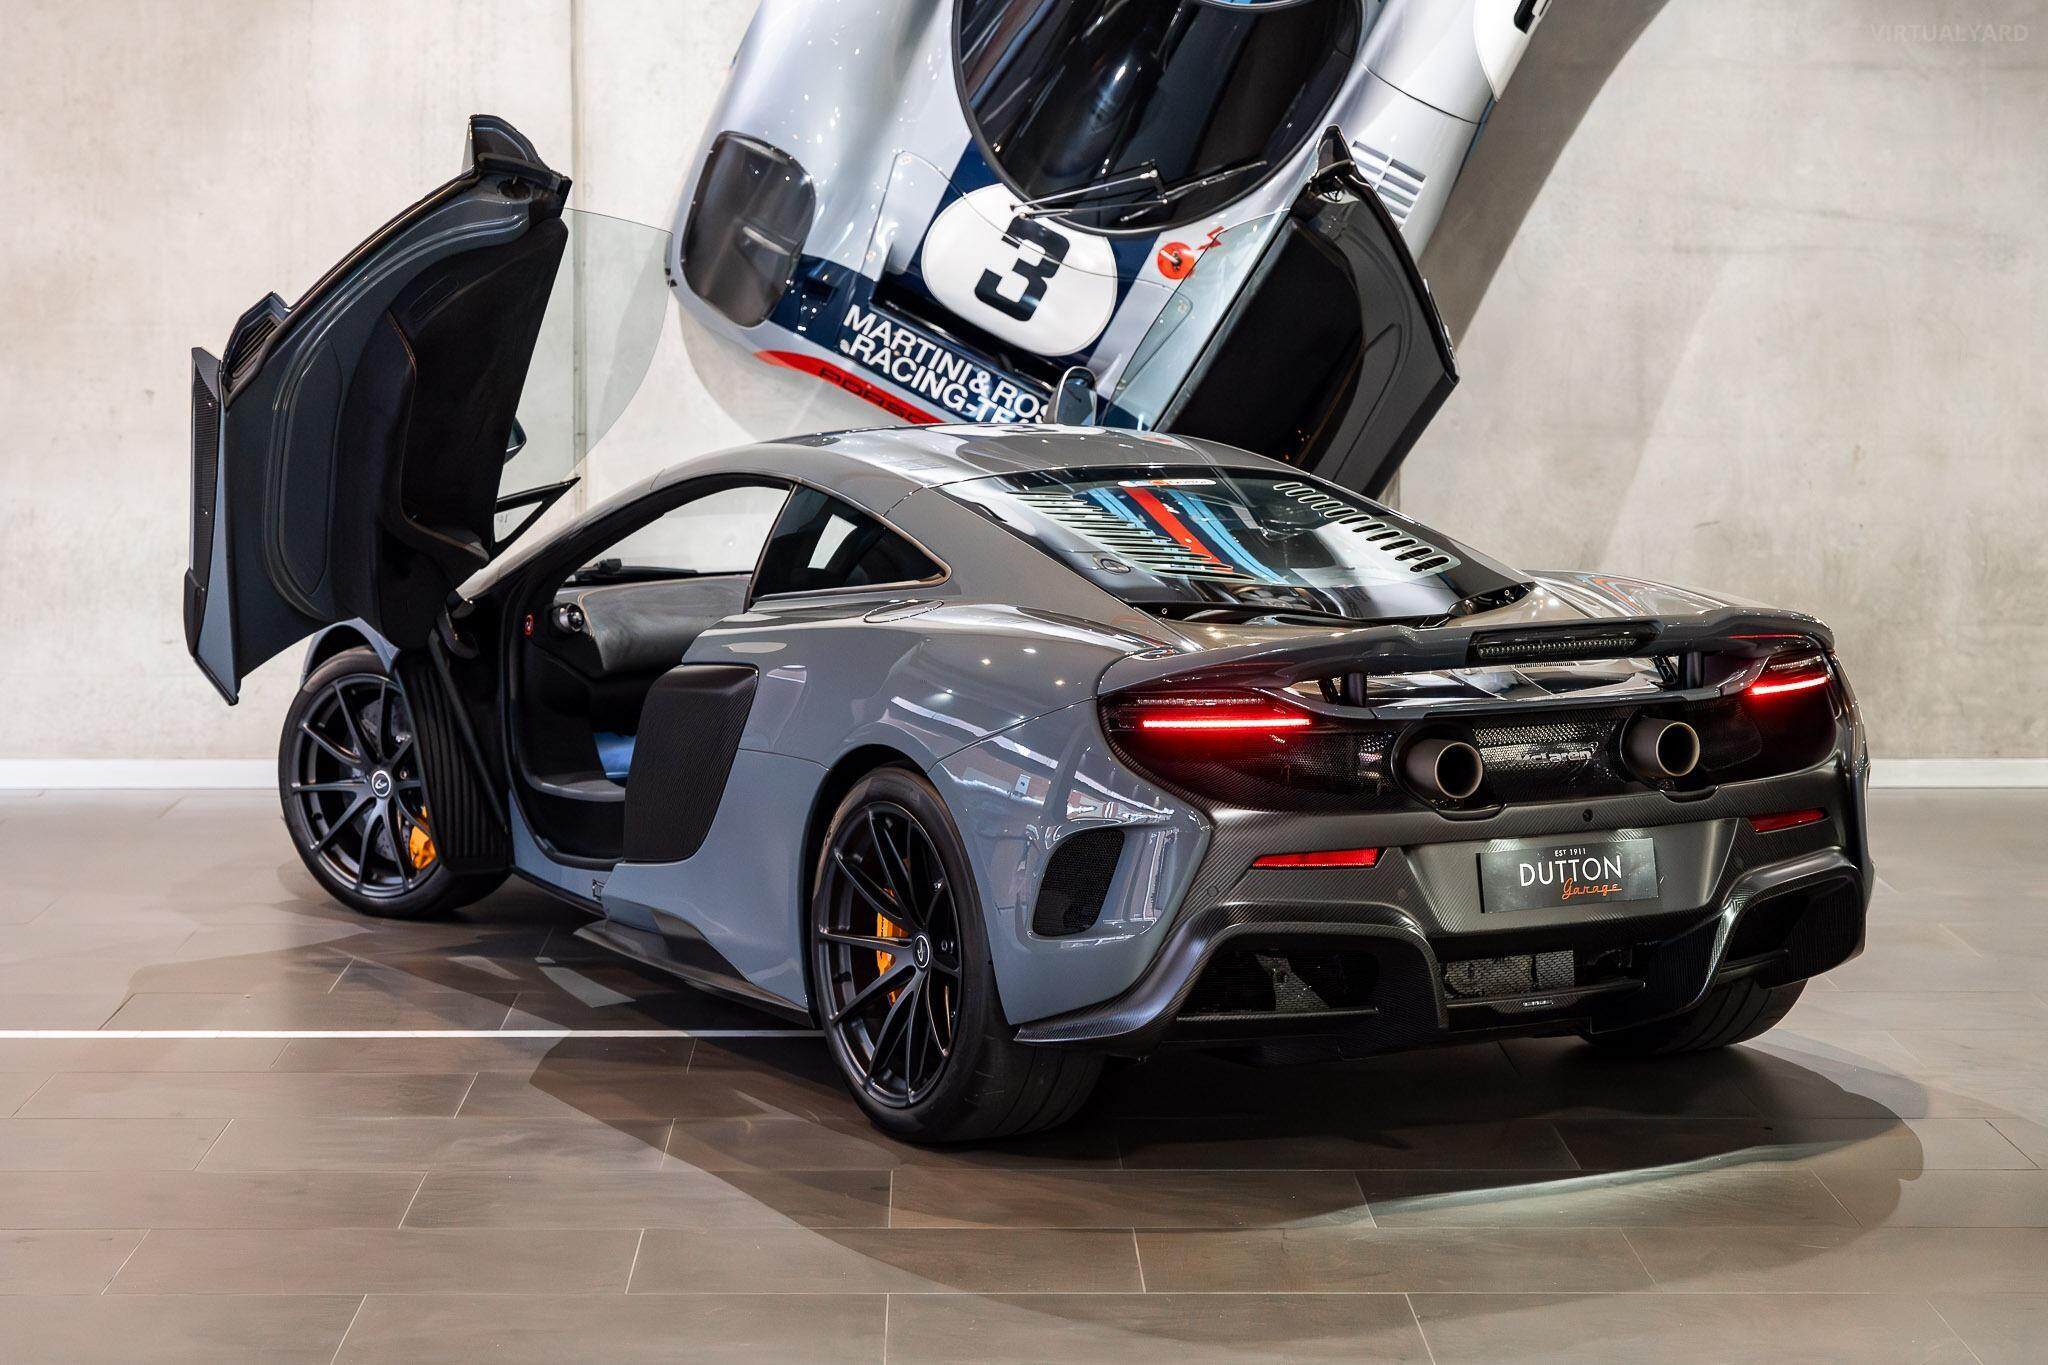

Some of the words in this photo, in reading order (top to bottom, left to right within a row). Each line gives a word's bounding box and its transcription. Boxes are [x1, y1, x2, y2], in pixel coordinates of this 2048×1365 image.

[974, 214, 1071, 322] 3
[843, 303, 974, 386] MARTINI
[1554, 849, 1567, 857] EST
[1570, 848, 1587, 856] 1911
[1519, 854, 1623, 887] DUTTON
[1561, 877, 1623, 900] Garage
